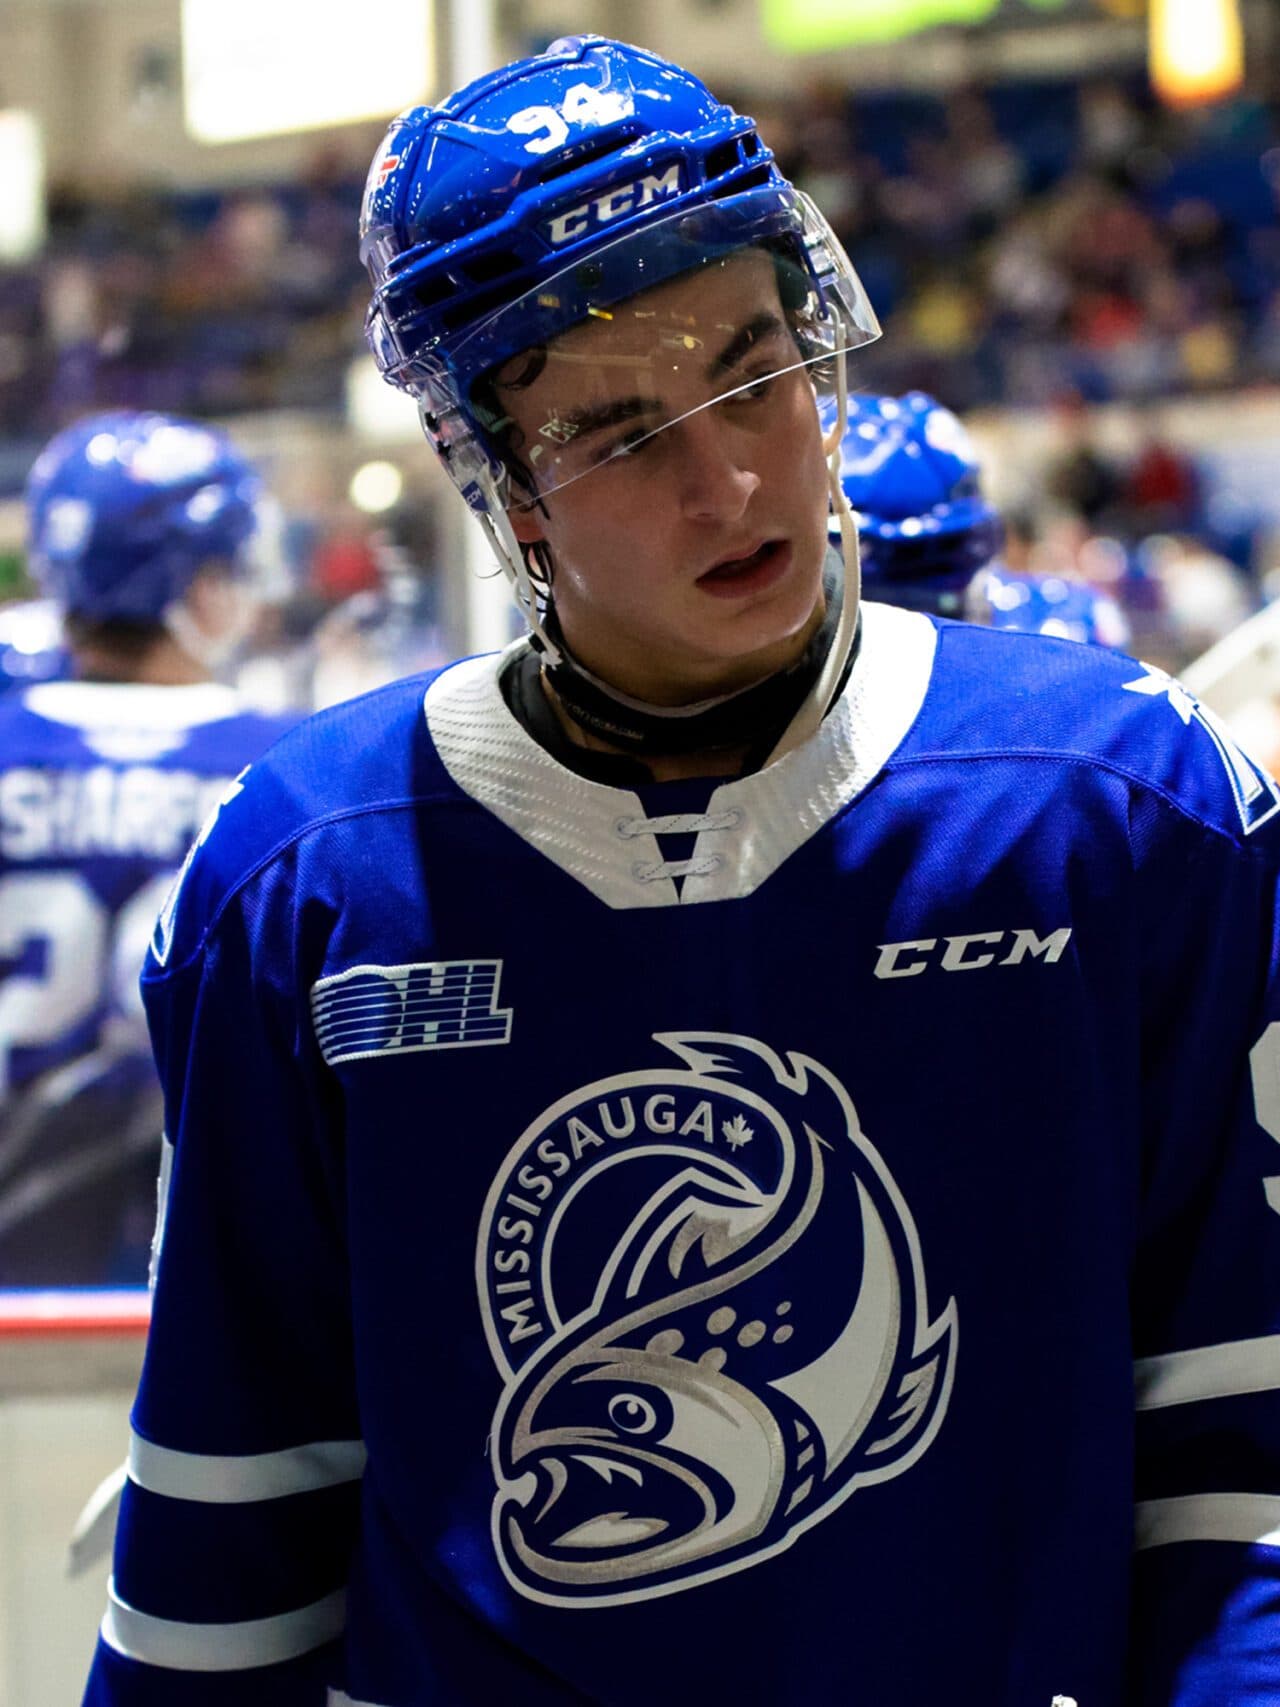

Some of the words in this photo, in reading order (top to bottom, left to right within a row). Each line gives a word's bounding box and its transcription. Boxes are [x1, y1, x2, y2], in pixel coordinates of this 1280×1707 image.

[506, 83, 634, 154] 94
[548, 164, 679, 243] CCM
[873, 927, 1072, 979] CCM
[311, 959, 513, 1066] OHL
[495, 1094, 714, 1344] MISSISSAUGA
